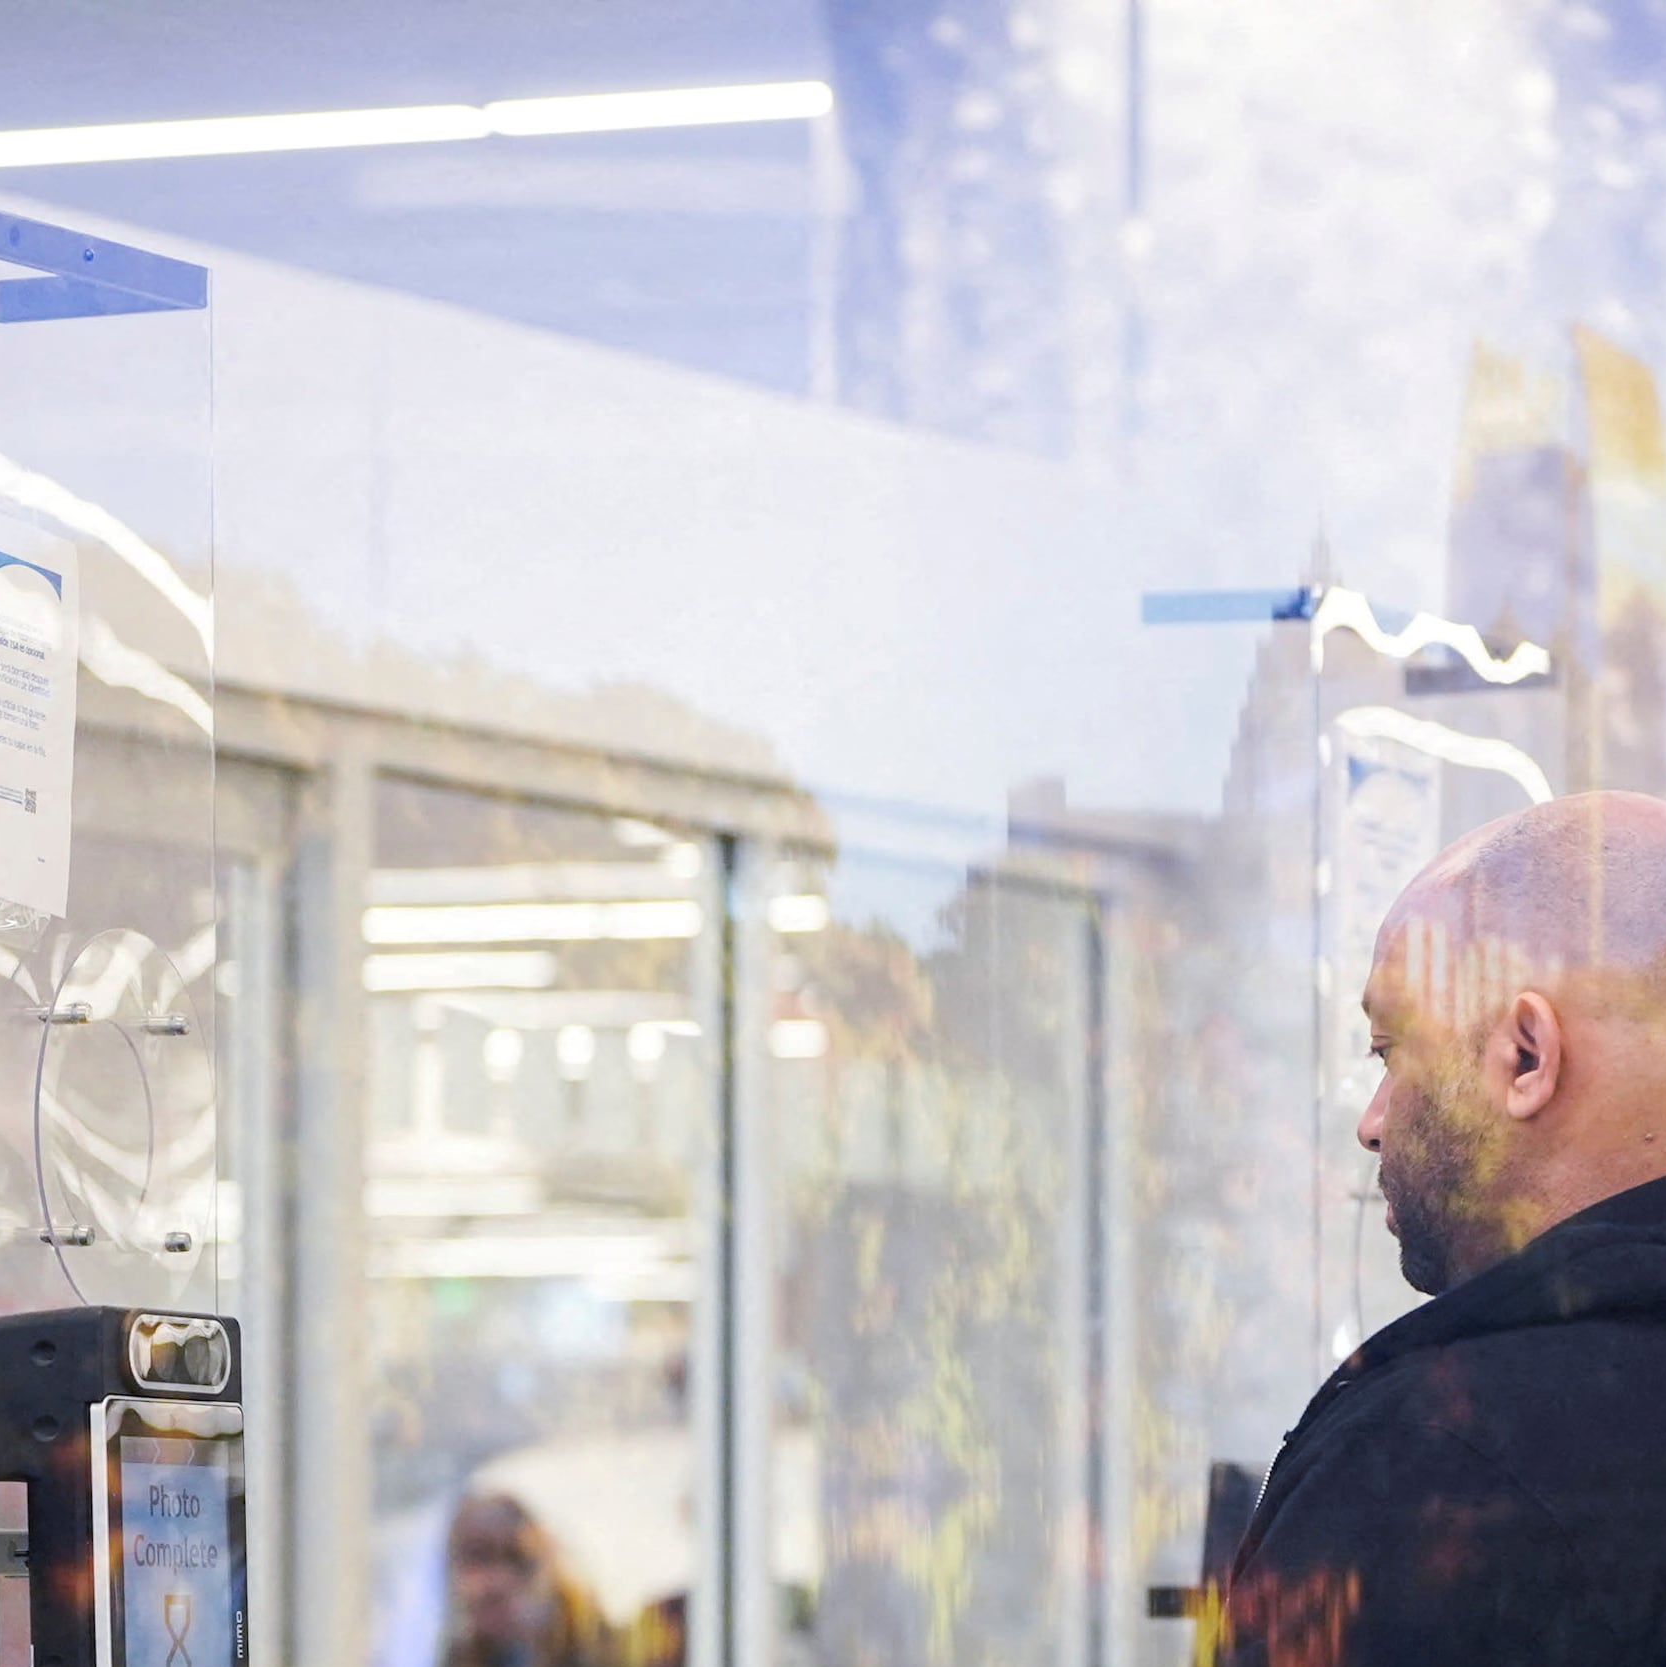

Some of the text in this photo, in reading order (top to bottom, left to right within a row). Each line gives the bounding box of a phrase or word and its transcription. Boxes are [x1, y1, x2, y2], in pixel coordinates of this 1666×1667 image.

[149, 1484, 200, 1518] Photo
[133, 1534, 218, 1576] Complete
[236, 1611, 244, 1658] mimo
